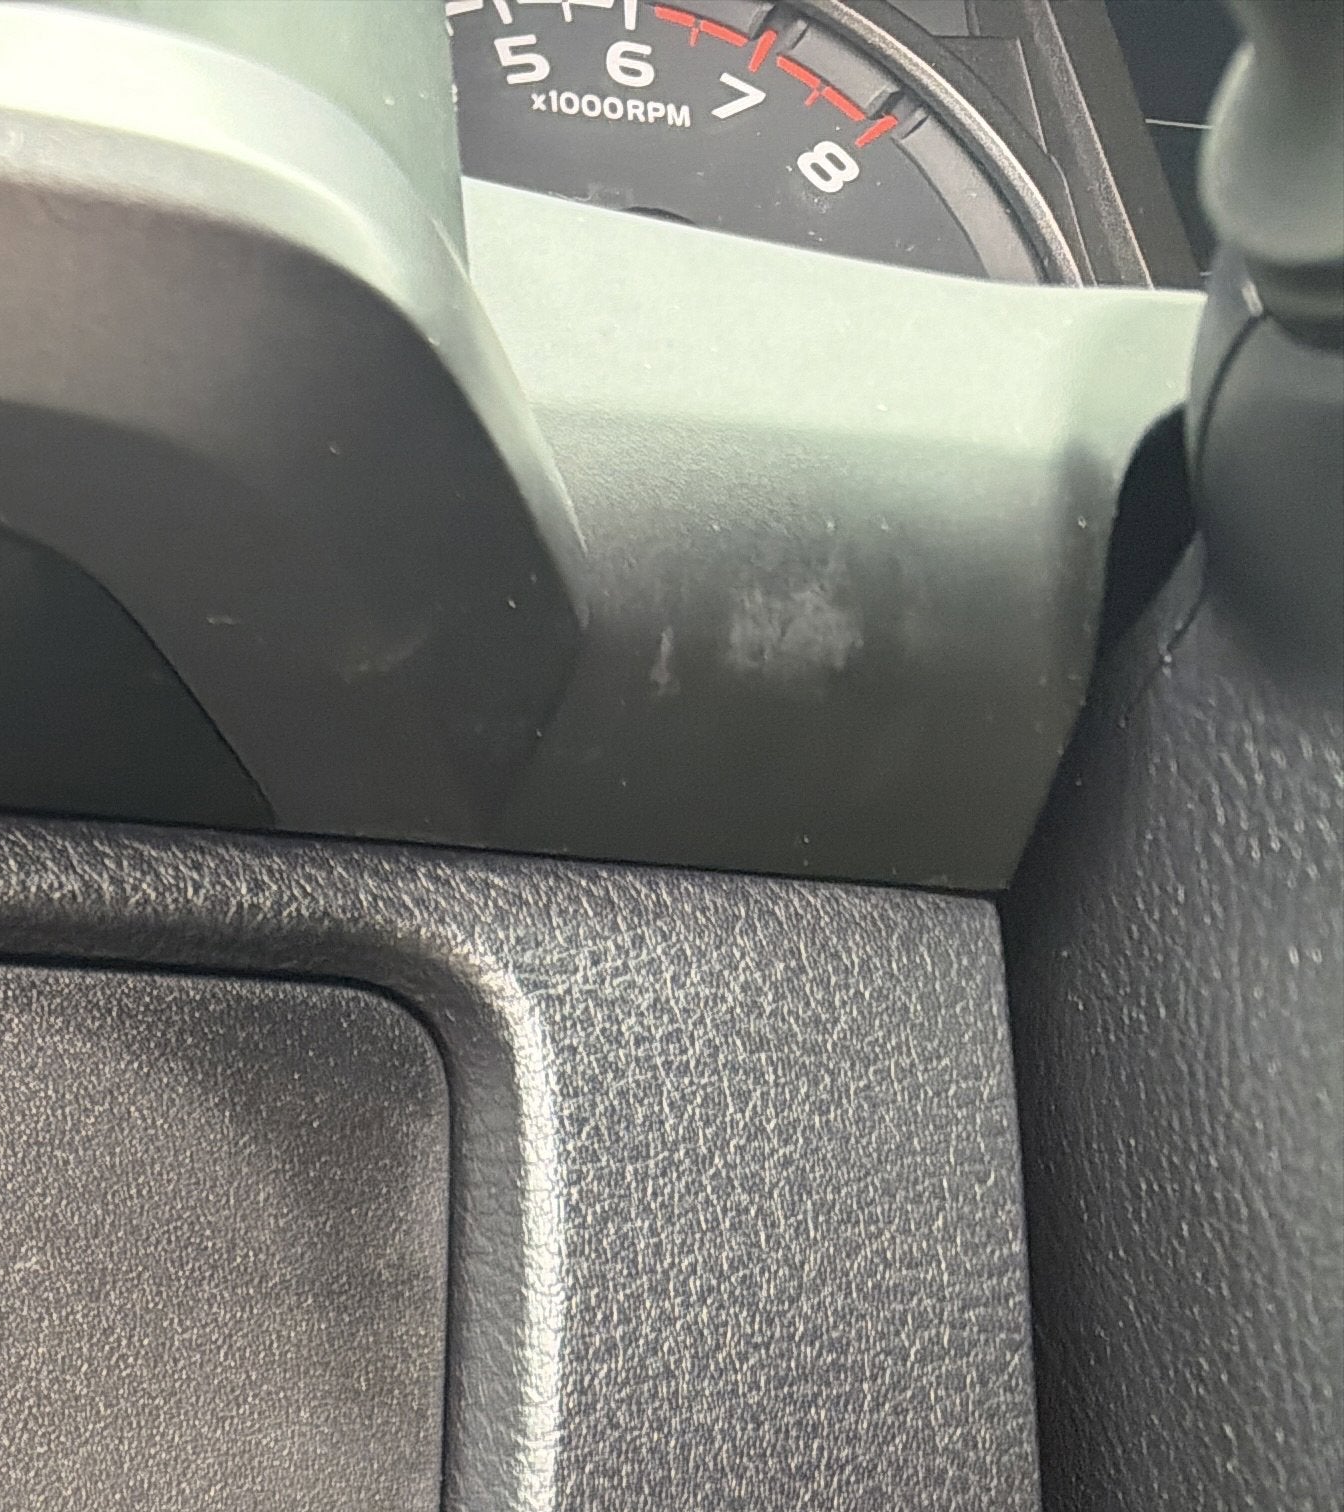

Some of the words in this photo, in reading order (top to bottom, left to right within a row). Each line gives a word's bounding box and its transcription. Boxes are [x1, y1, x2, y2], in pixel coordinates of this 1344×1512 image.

[494, 34, 550, 85] 5
[606, 40, 655, 87] 6
[712, 72, 766, 119] 7
[797, 141, 859, 193] 8
[531, 90, 691, 128] x1000RPM
